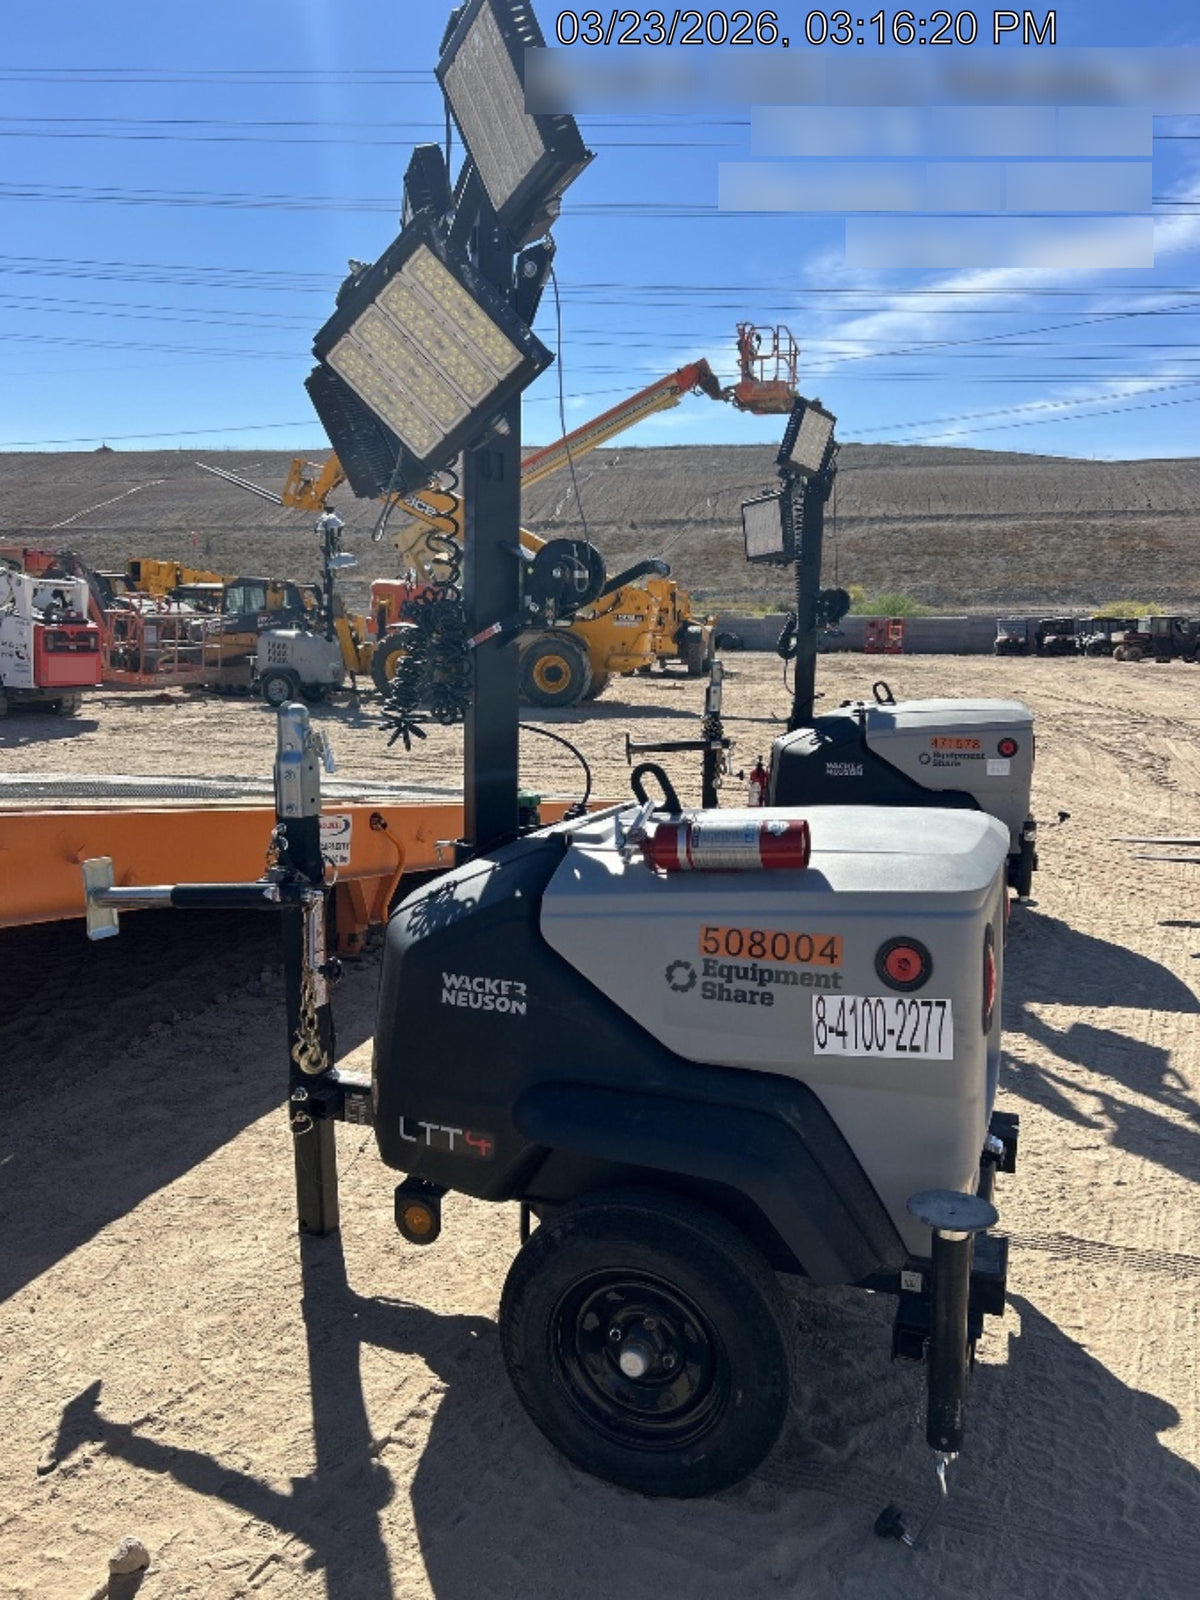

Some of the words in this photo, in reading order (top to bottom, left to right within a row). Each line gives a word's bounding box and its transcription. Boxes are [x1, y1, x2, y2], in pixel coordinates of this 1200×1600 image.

[703, 927, 838, 964] 508004
[442, 972, 527, 997] WACKER
[701, 958, 843, 990] Equipment
[442, 988, 527, 1016] NEUSON
[701, 980, 775, 1006] Share
[815, 995, 947, 1053] 8-4100-2277
[399, 1115, 491, 1157] LTT4
